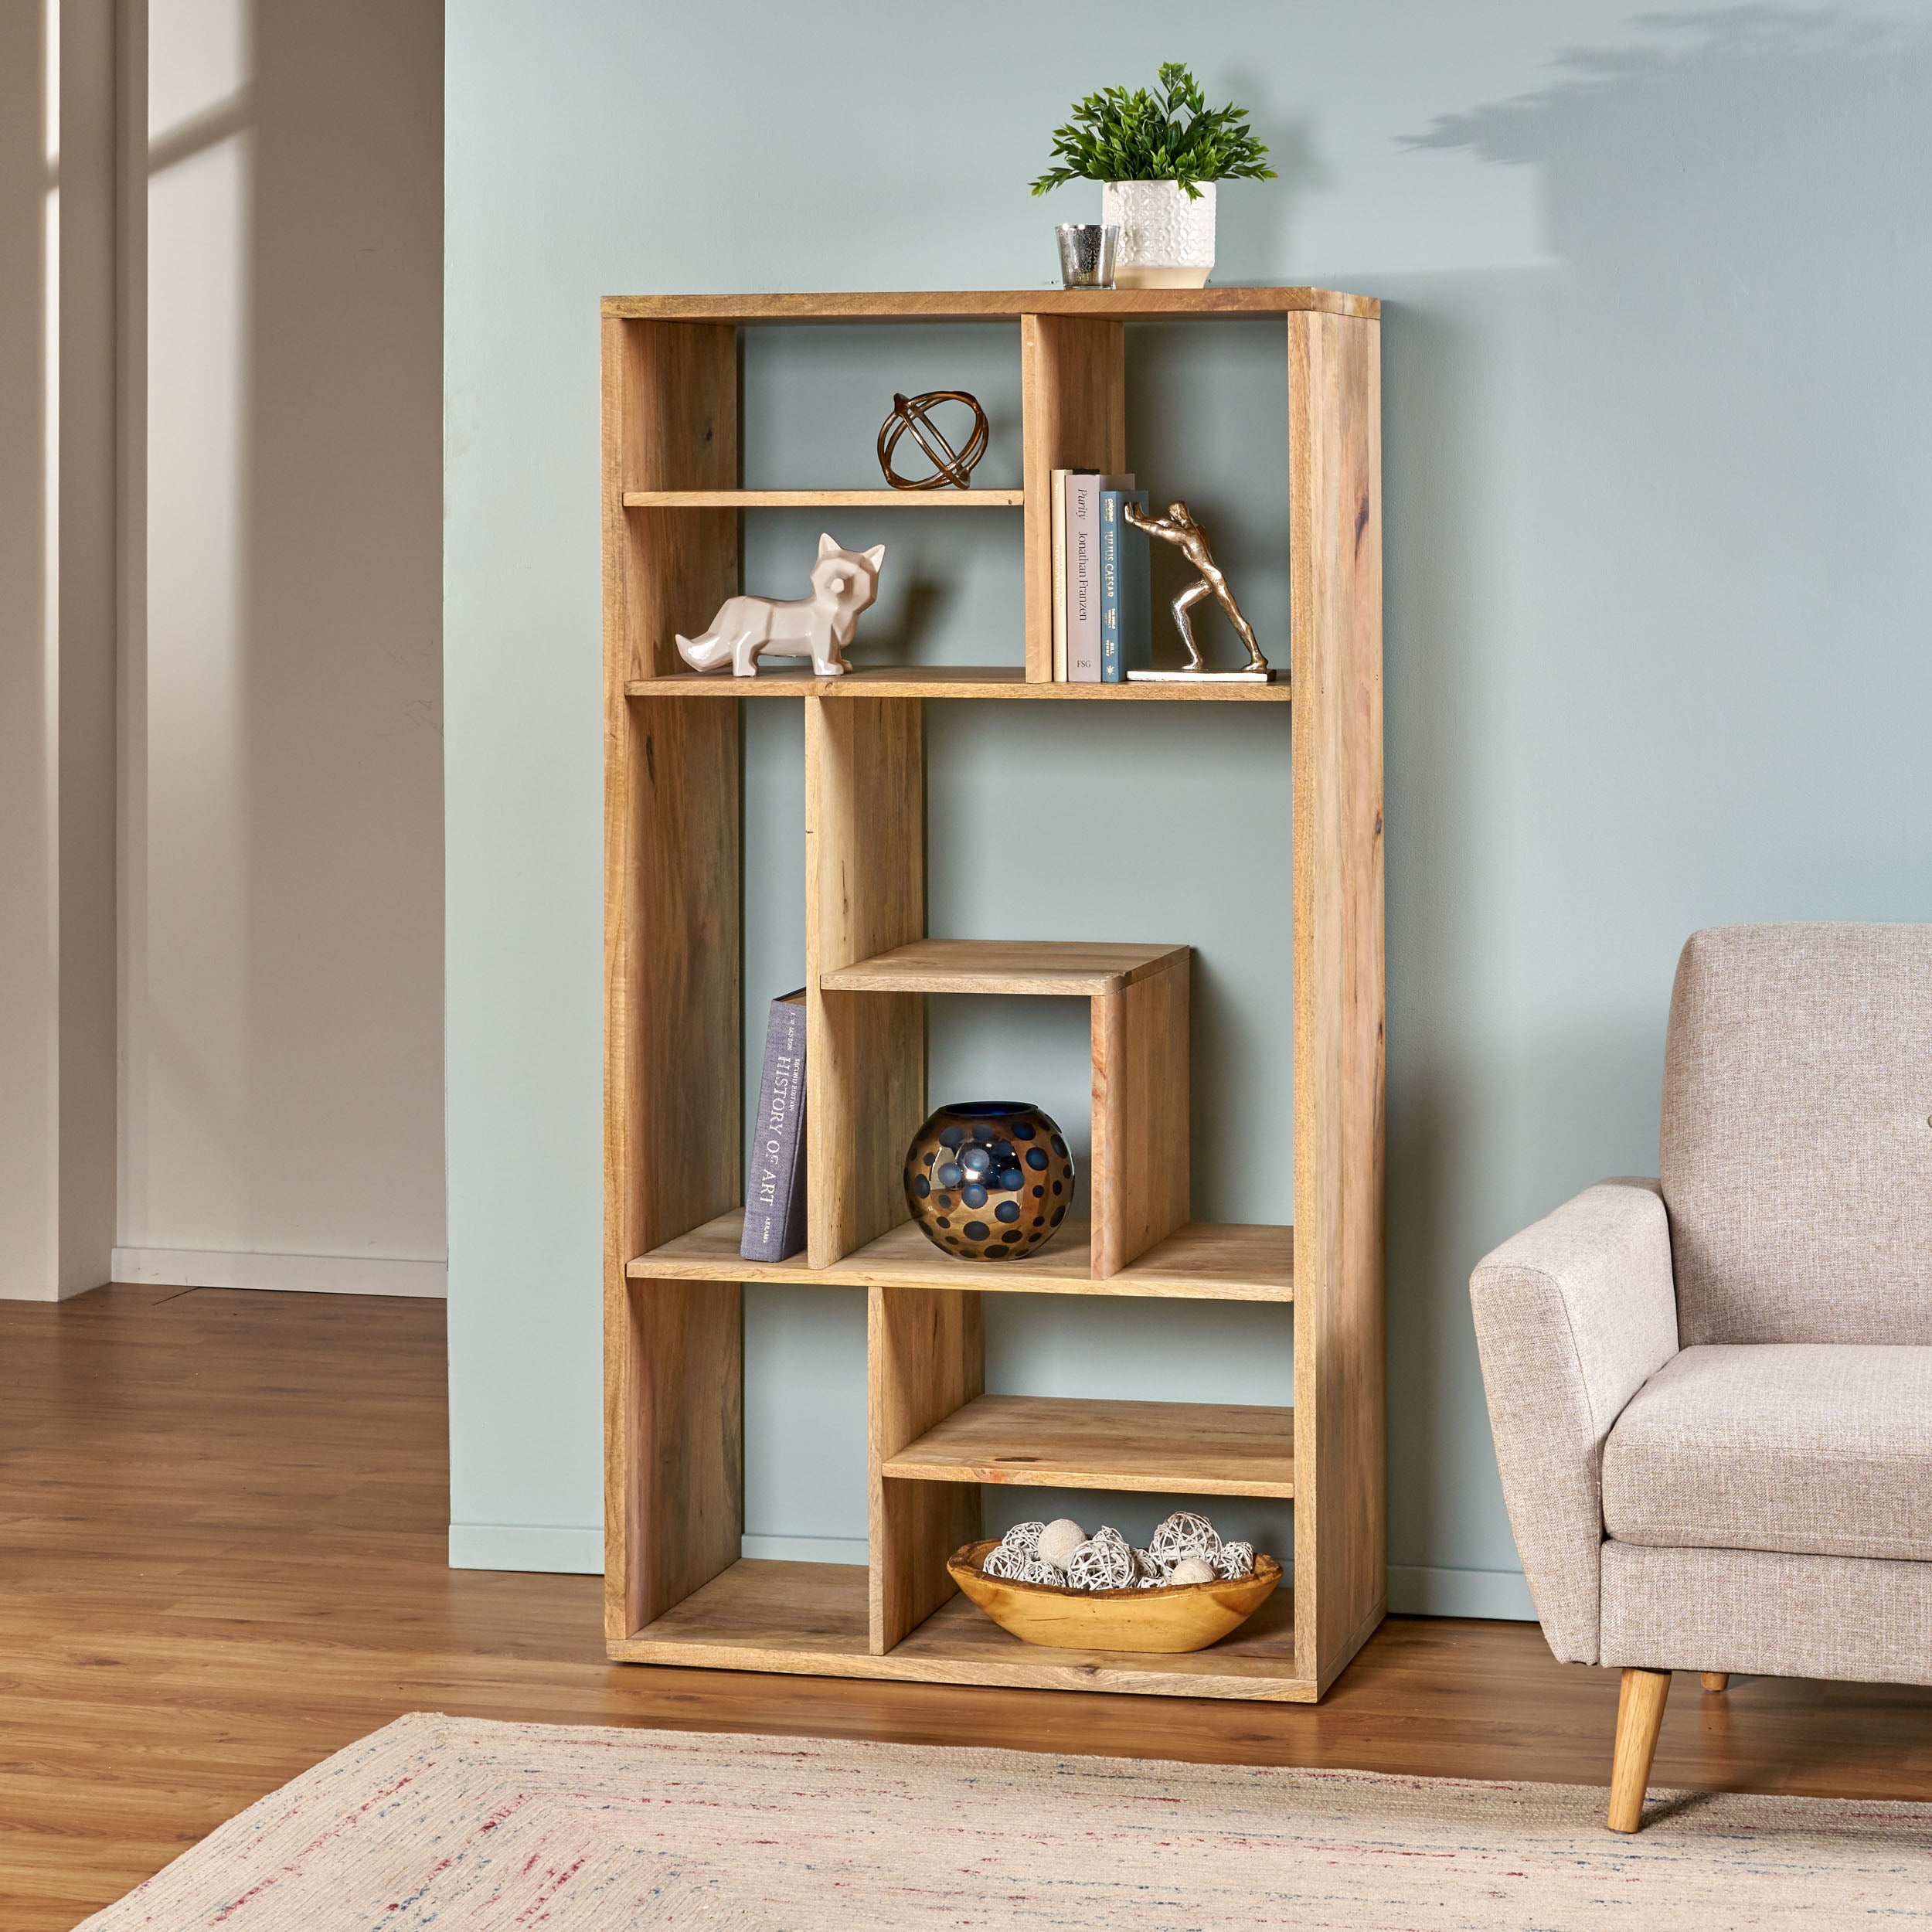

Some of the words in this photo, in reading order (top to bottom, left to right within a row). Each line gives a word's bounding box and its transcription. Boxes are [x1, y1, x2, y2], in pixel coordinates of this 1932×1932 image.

[1076, 488, 1087, 520] Purity
[1078, 532, 1088, 578] Jonathan
[1104, 563, 1114, 597] CAESAR
[1079, 580, 1089, 621] Franzen
[768, 1056, 791, 1135] HISTORY
[789, 1085, 798, 1112] EDITION
[764, 1140, 780, 1165] OF
[760, 1168, 777, 1206] ART
[763, 1216, 771, 1243] ABRAMS
